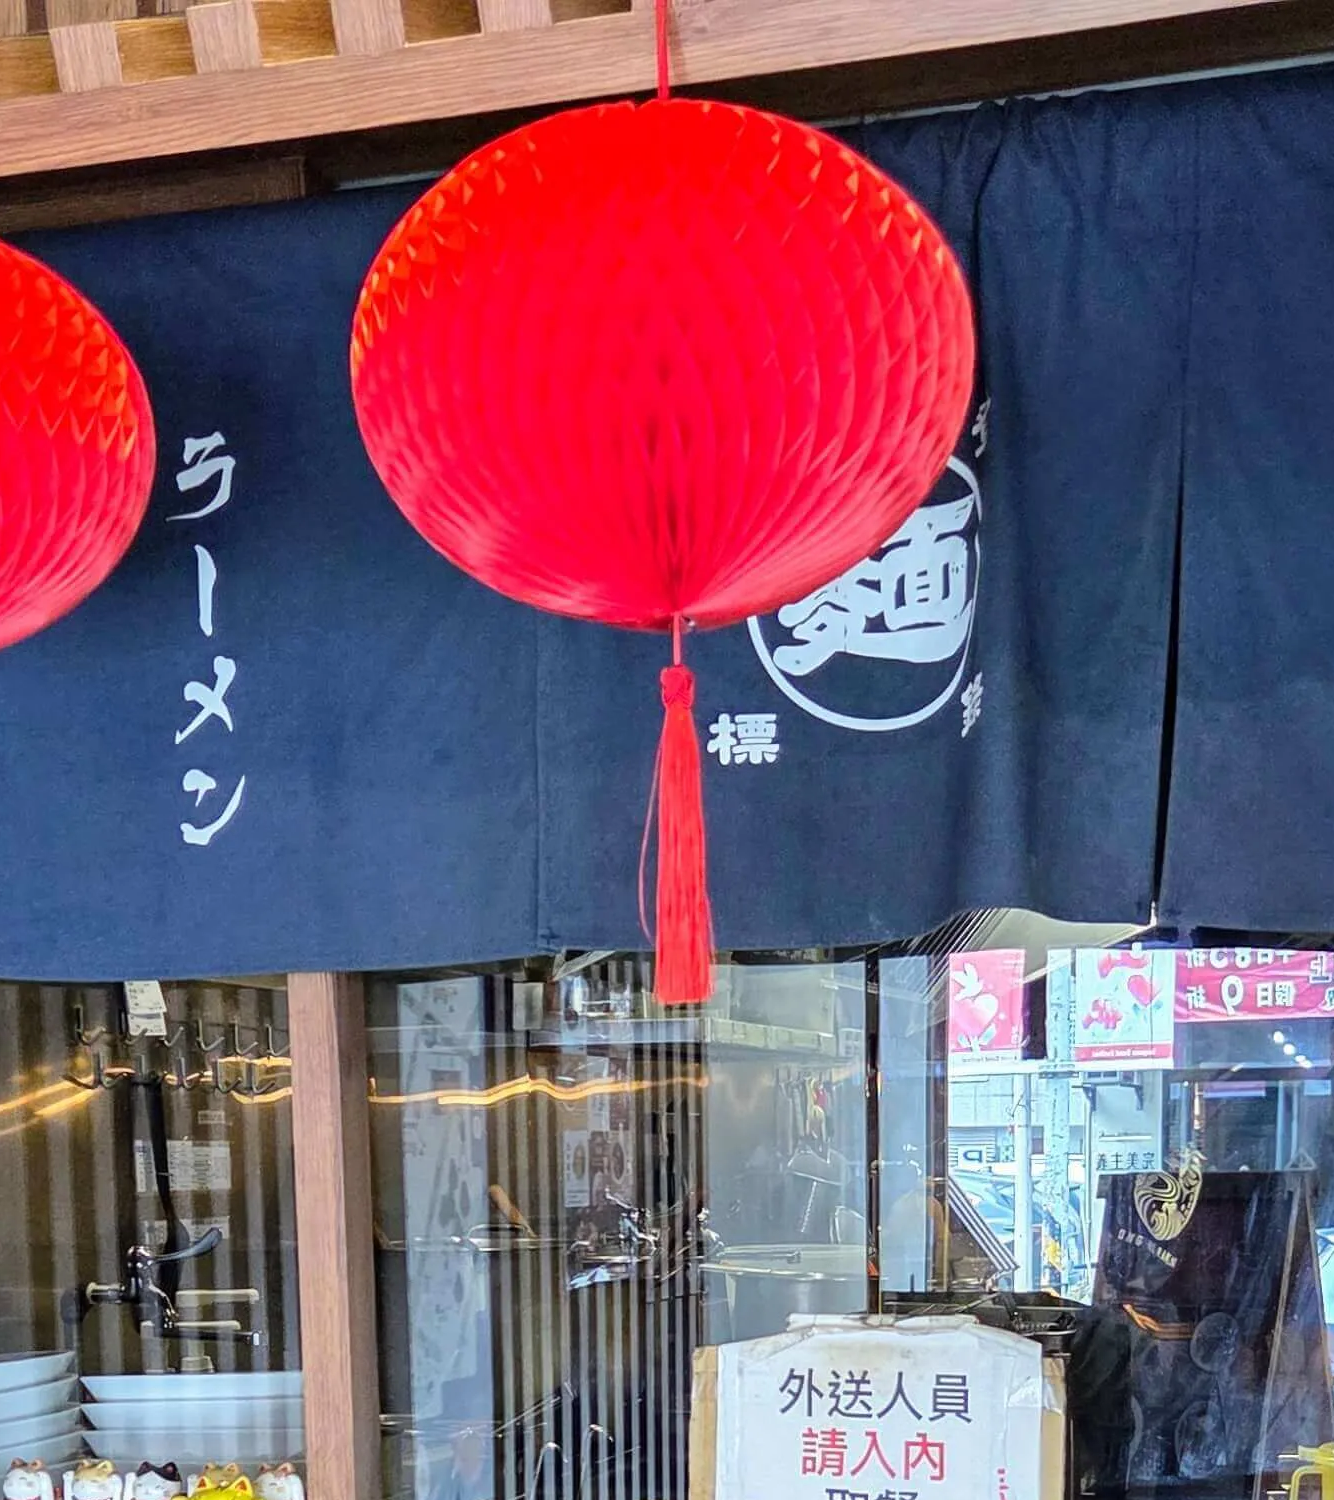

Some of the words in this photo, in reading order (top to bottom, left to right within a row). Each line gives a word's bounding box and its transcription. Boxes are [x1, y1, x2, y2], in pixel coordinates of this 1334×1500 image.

[166, 430, 246, 846] ラーメン
[778, 1367, 973, 1424] 外送人員
[801, 1427, 947, 1482] 請入內
